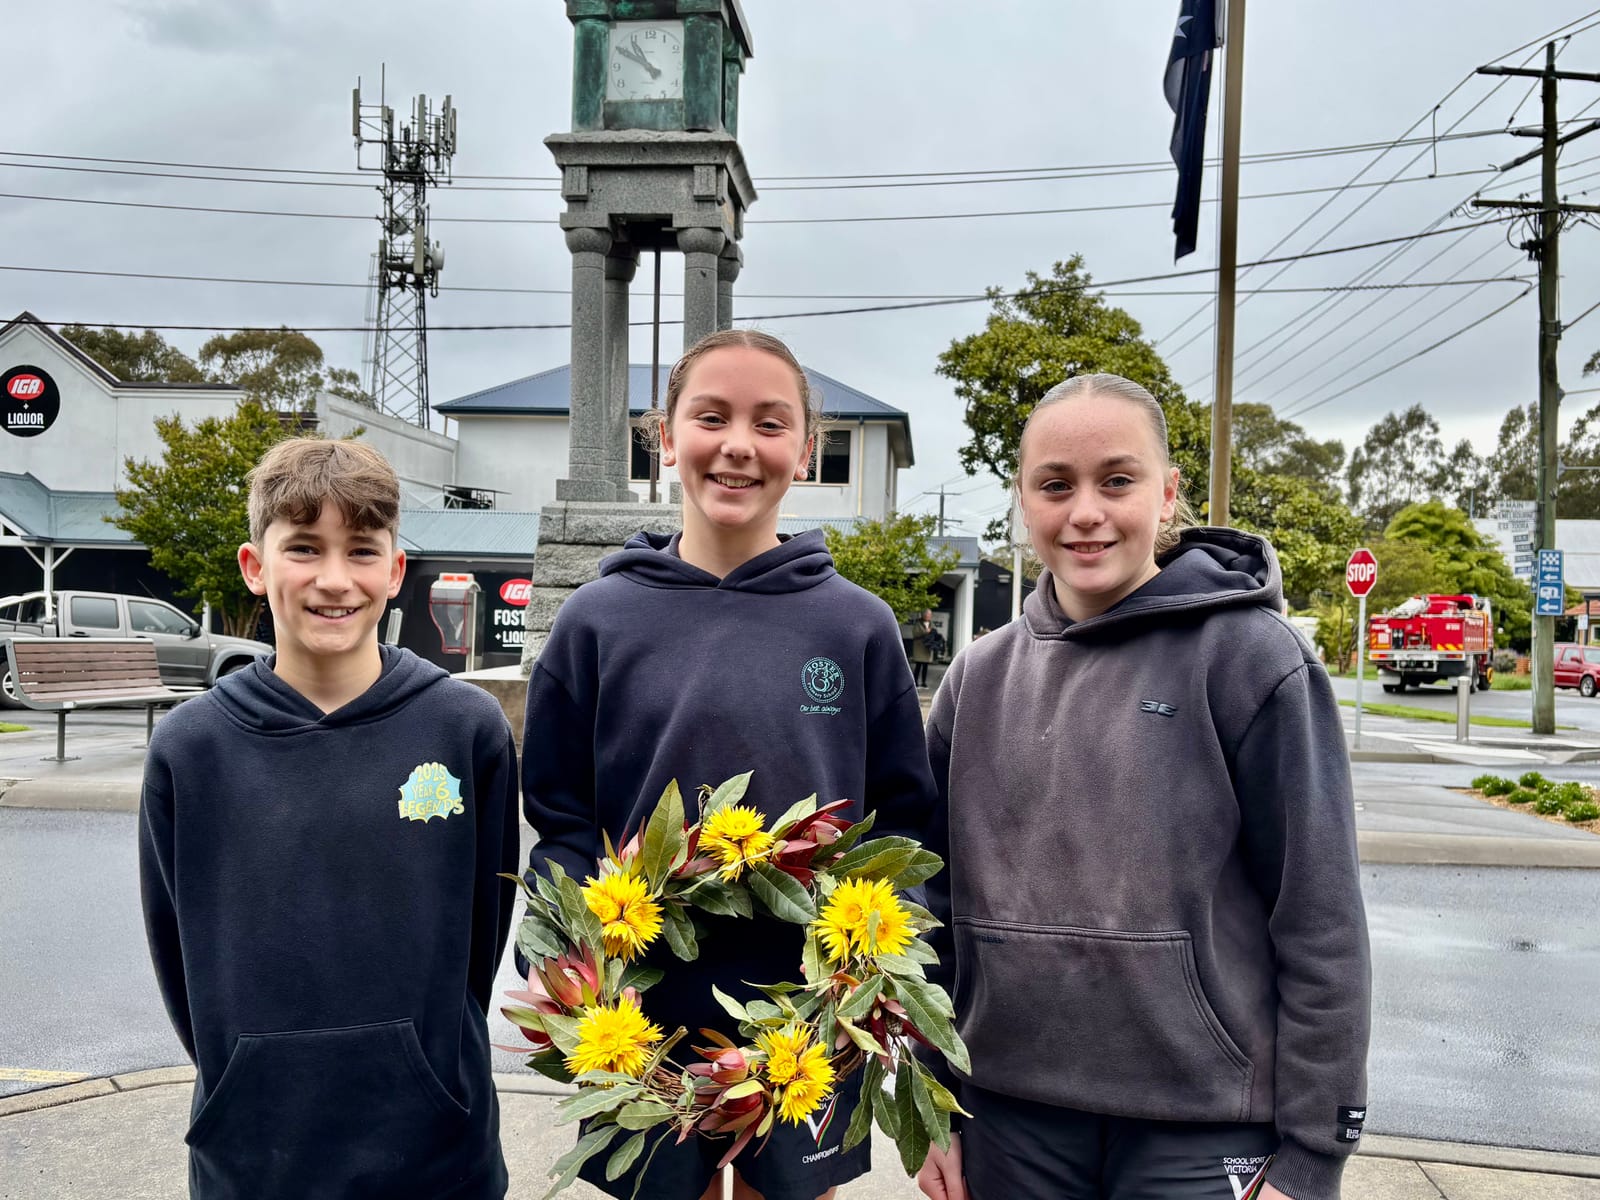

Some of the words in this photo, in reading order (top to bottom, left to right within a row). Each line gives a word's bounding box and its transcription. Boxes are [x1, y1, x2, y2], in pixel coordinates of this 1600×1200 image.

[645, 30, 657, 40] 12
[10, 378, 41, 395] IGA
[7, 412, 44, 425] LIQUOR
[1348, 563, 1375, 582] STOP
[494, 609, 526, 626] FOST
[502, 630, 526, 643] LIQU
[806, 661, 841, 681] FOSTER
[415, 761, 448, 783] 2025
[411, 783, 433, 801] YEAR
[435, 781, 450, 800] 6
[398, 796, 465, 819] LEGENDS
[1222, 1156, 1249, 1165] SCHOOL
[1249, 1156, 1266, 1165] SPORT
[1223, 1164, 1258, 1174] VICTORIA
